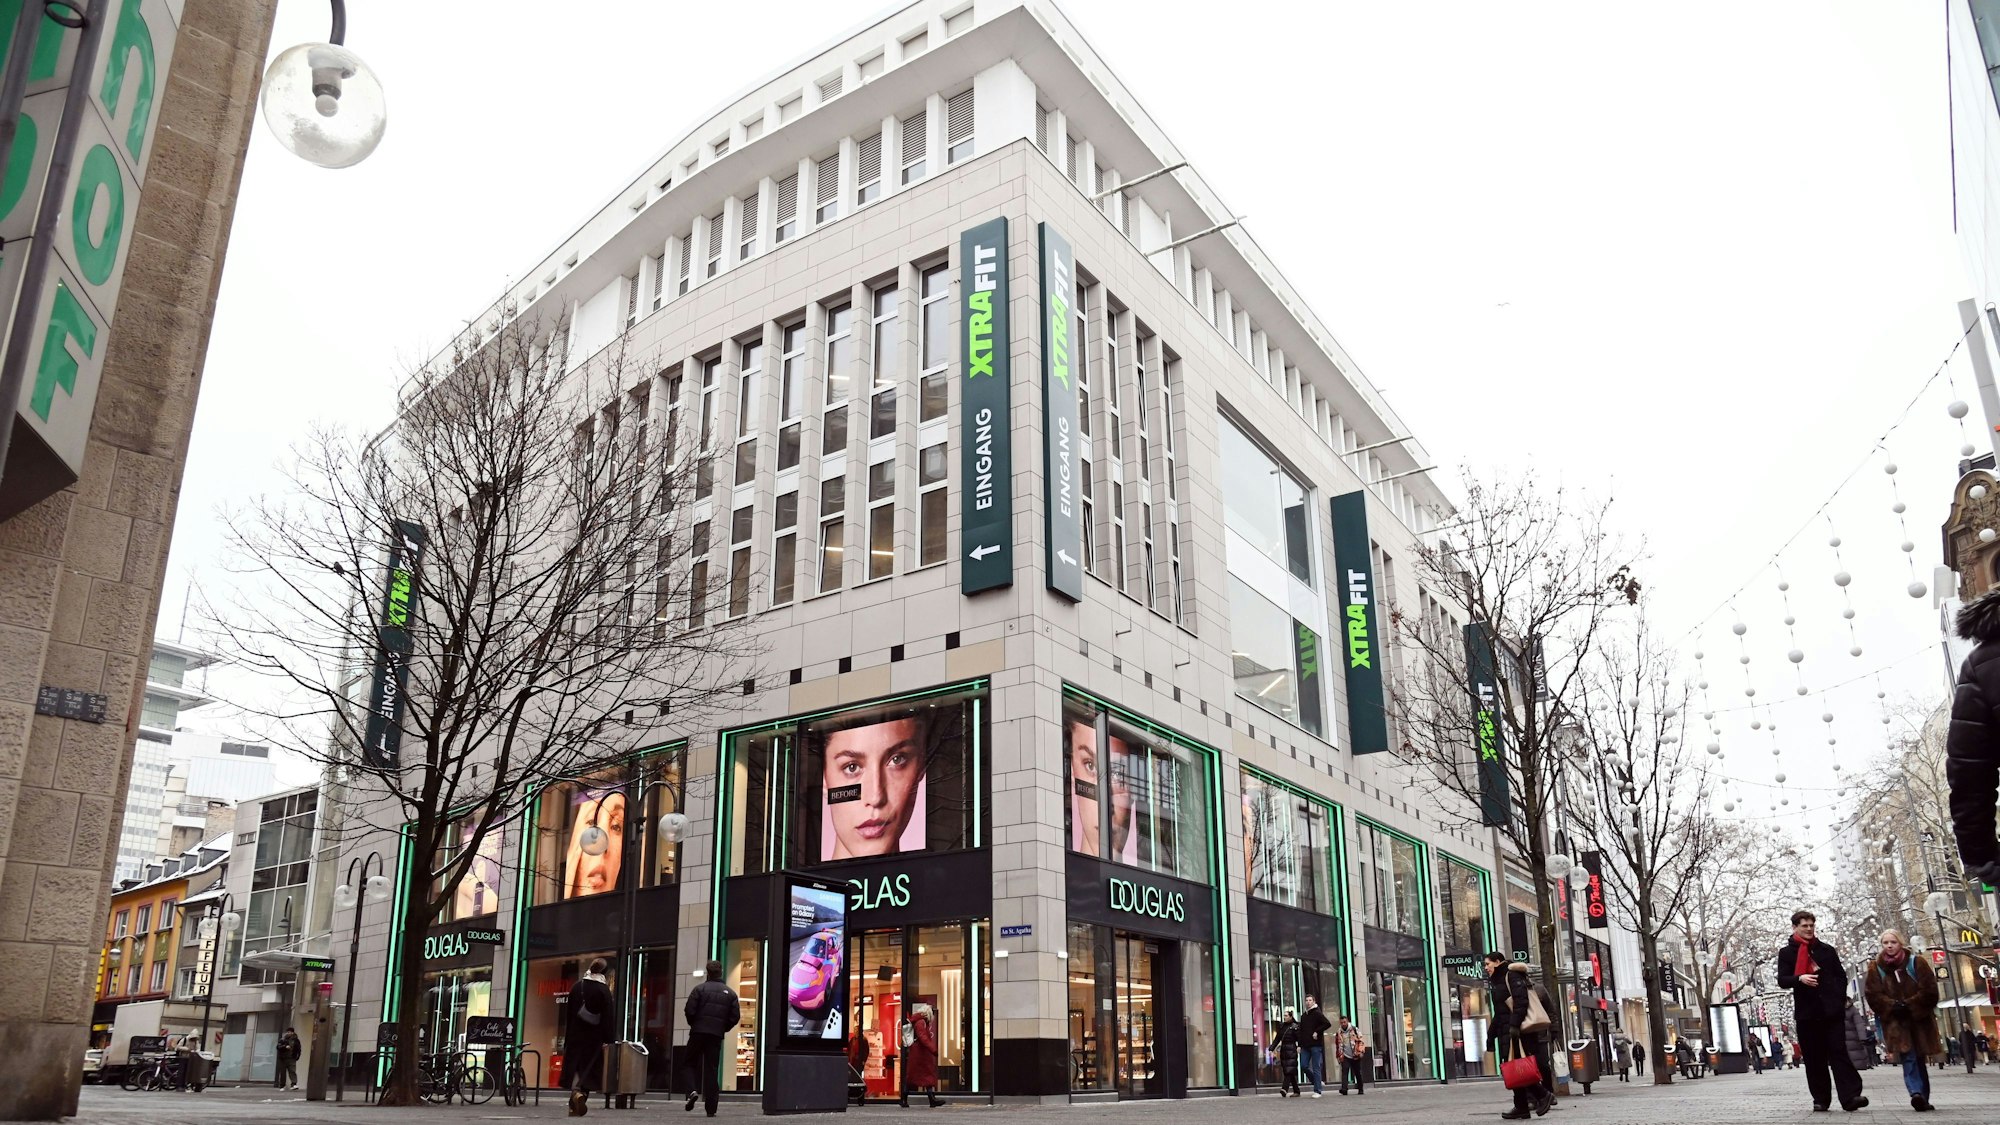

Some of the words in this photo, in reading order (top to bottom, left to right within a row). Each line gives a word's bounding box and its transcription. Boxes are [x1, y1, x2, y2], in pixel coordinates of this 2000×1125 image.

[969, 245, 998, 379] XTRAFIT
[1050, 251, 1069, 391] XTRAFIT
[975, 407, 993, 511] EINGANG
[1060, 415, 1072, 518] EINGANG
[1346, 568, 1371, 670] XTRAFIT
[831, 788, 858, 800] BEFORE
[792, 903, 815, 912] Prompted
[799, 910, 815, 920] Galaxy
[1110, 877, 1185, 923] DOUGLAS
[199, 908, 217, 995] CFFEUR
[467, 930, 501, 941] DOUGLAS
[305, 961, 332, 969] XTRAFIT
[1445, 956, 1472, 965] DOUGLAS
